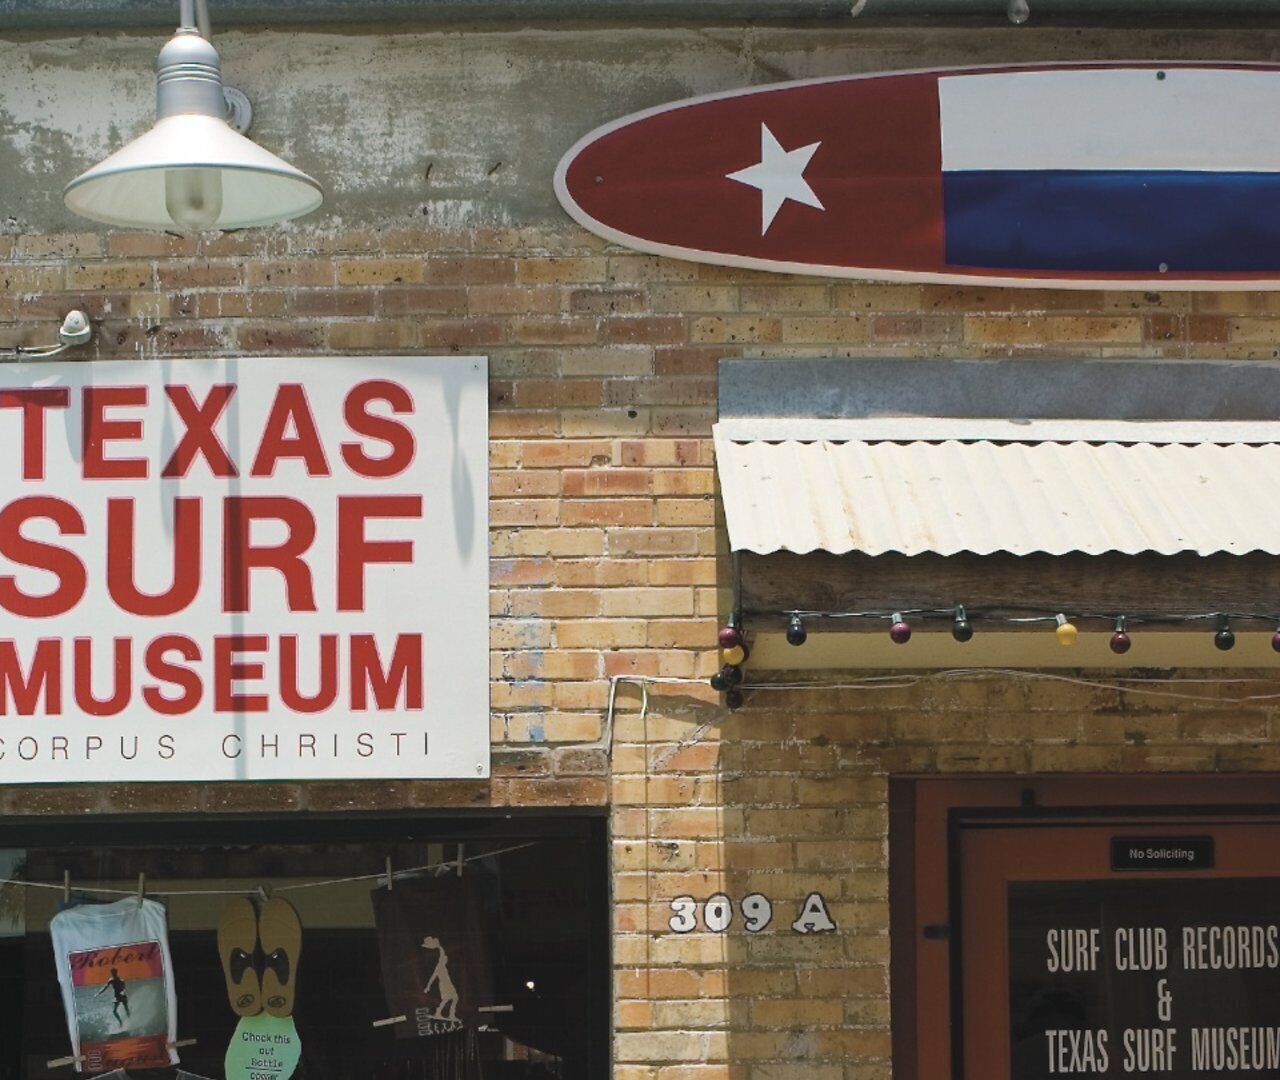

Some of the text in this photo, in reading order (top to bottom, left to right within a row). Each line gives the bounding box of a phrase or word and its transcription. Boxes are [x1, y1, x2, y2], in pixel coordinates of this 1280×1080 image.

[221, 731, 430, 759] CHRISTI
[1128, 848, 1195, 861] No Soliciting
[669, 892, 837, 933] 309 A
[1047, 925, 1280, 973] SURF CLUB RECORDS
[1157, 979, 1173, 1021] &
[242, 1032, 291, 1044] Check this
[259, 1046, 275, 1056] out
[1045, 1029, 1109, 1073] TEXAS
[1123, 1028, 1177, 1072] SURF
